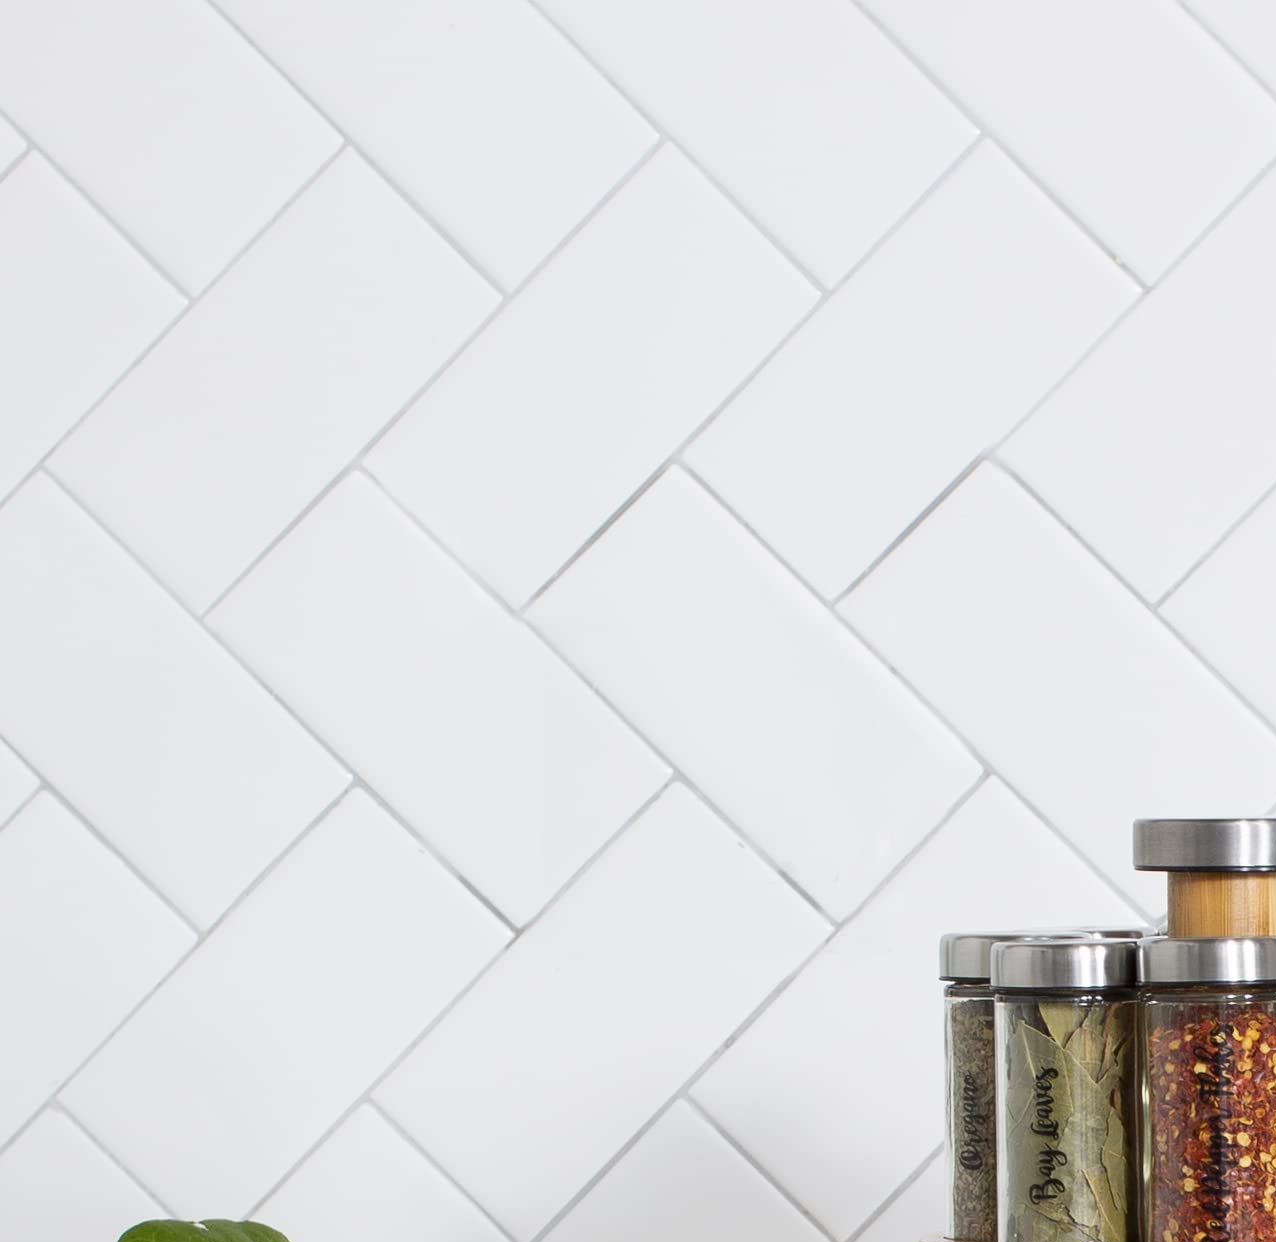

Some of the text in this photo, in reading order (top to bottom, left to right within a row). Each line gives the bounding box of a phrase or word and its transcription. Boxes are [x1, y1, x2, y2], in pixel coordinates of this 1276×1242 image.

[960, 1071, 986, 1171] Oregano
[1029, 1066, 1068, 1205] Bay Leaves
